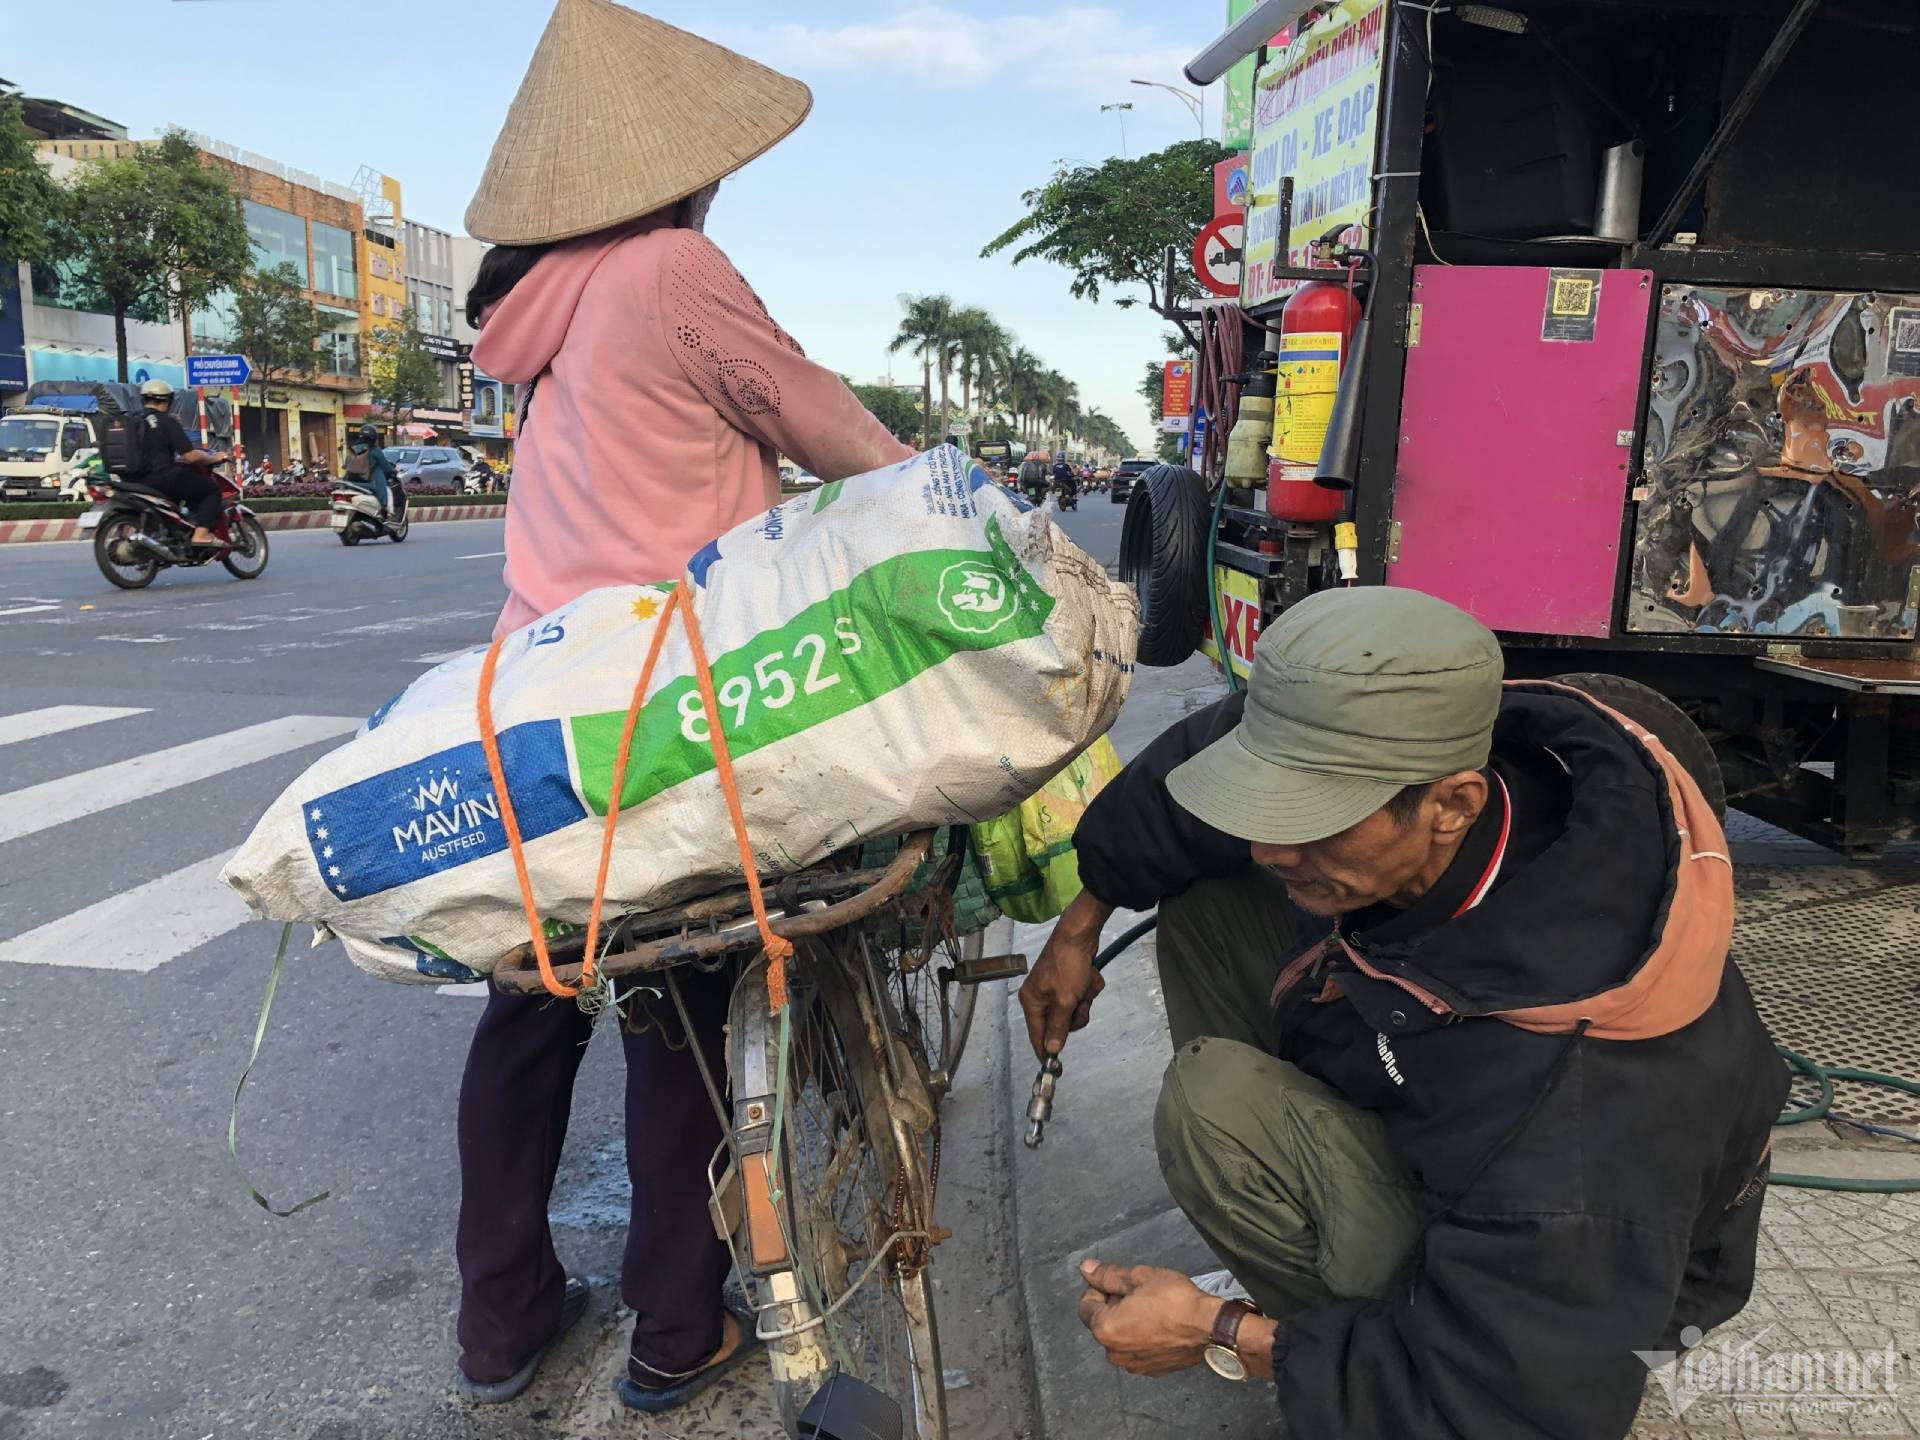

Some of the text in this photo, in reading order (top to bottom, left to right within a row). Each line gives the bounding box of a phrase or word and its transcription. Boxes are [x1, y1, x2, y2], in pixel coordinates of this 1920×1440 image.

[1280, 128, 1298, 177] DA
[1312, 107, 1334, 159] XE
[1337, 82, 1375, 149] ĐẠP
[392, 792, 499, 853] MAVIN
[421, 831, 486, 863] AUSTFEED
